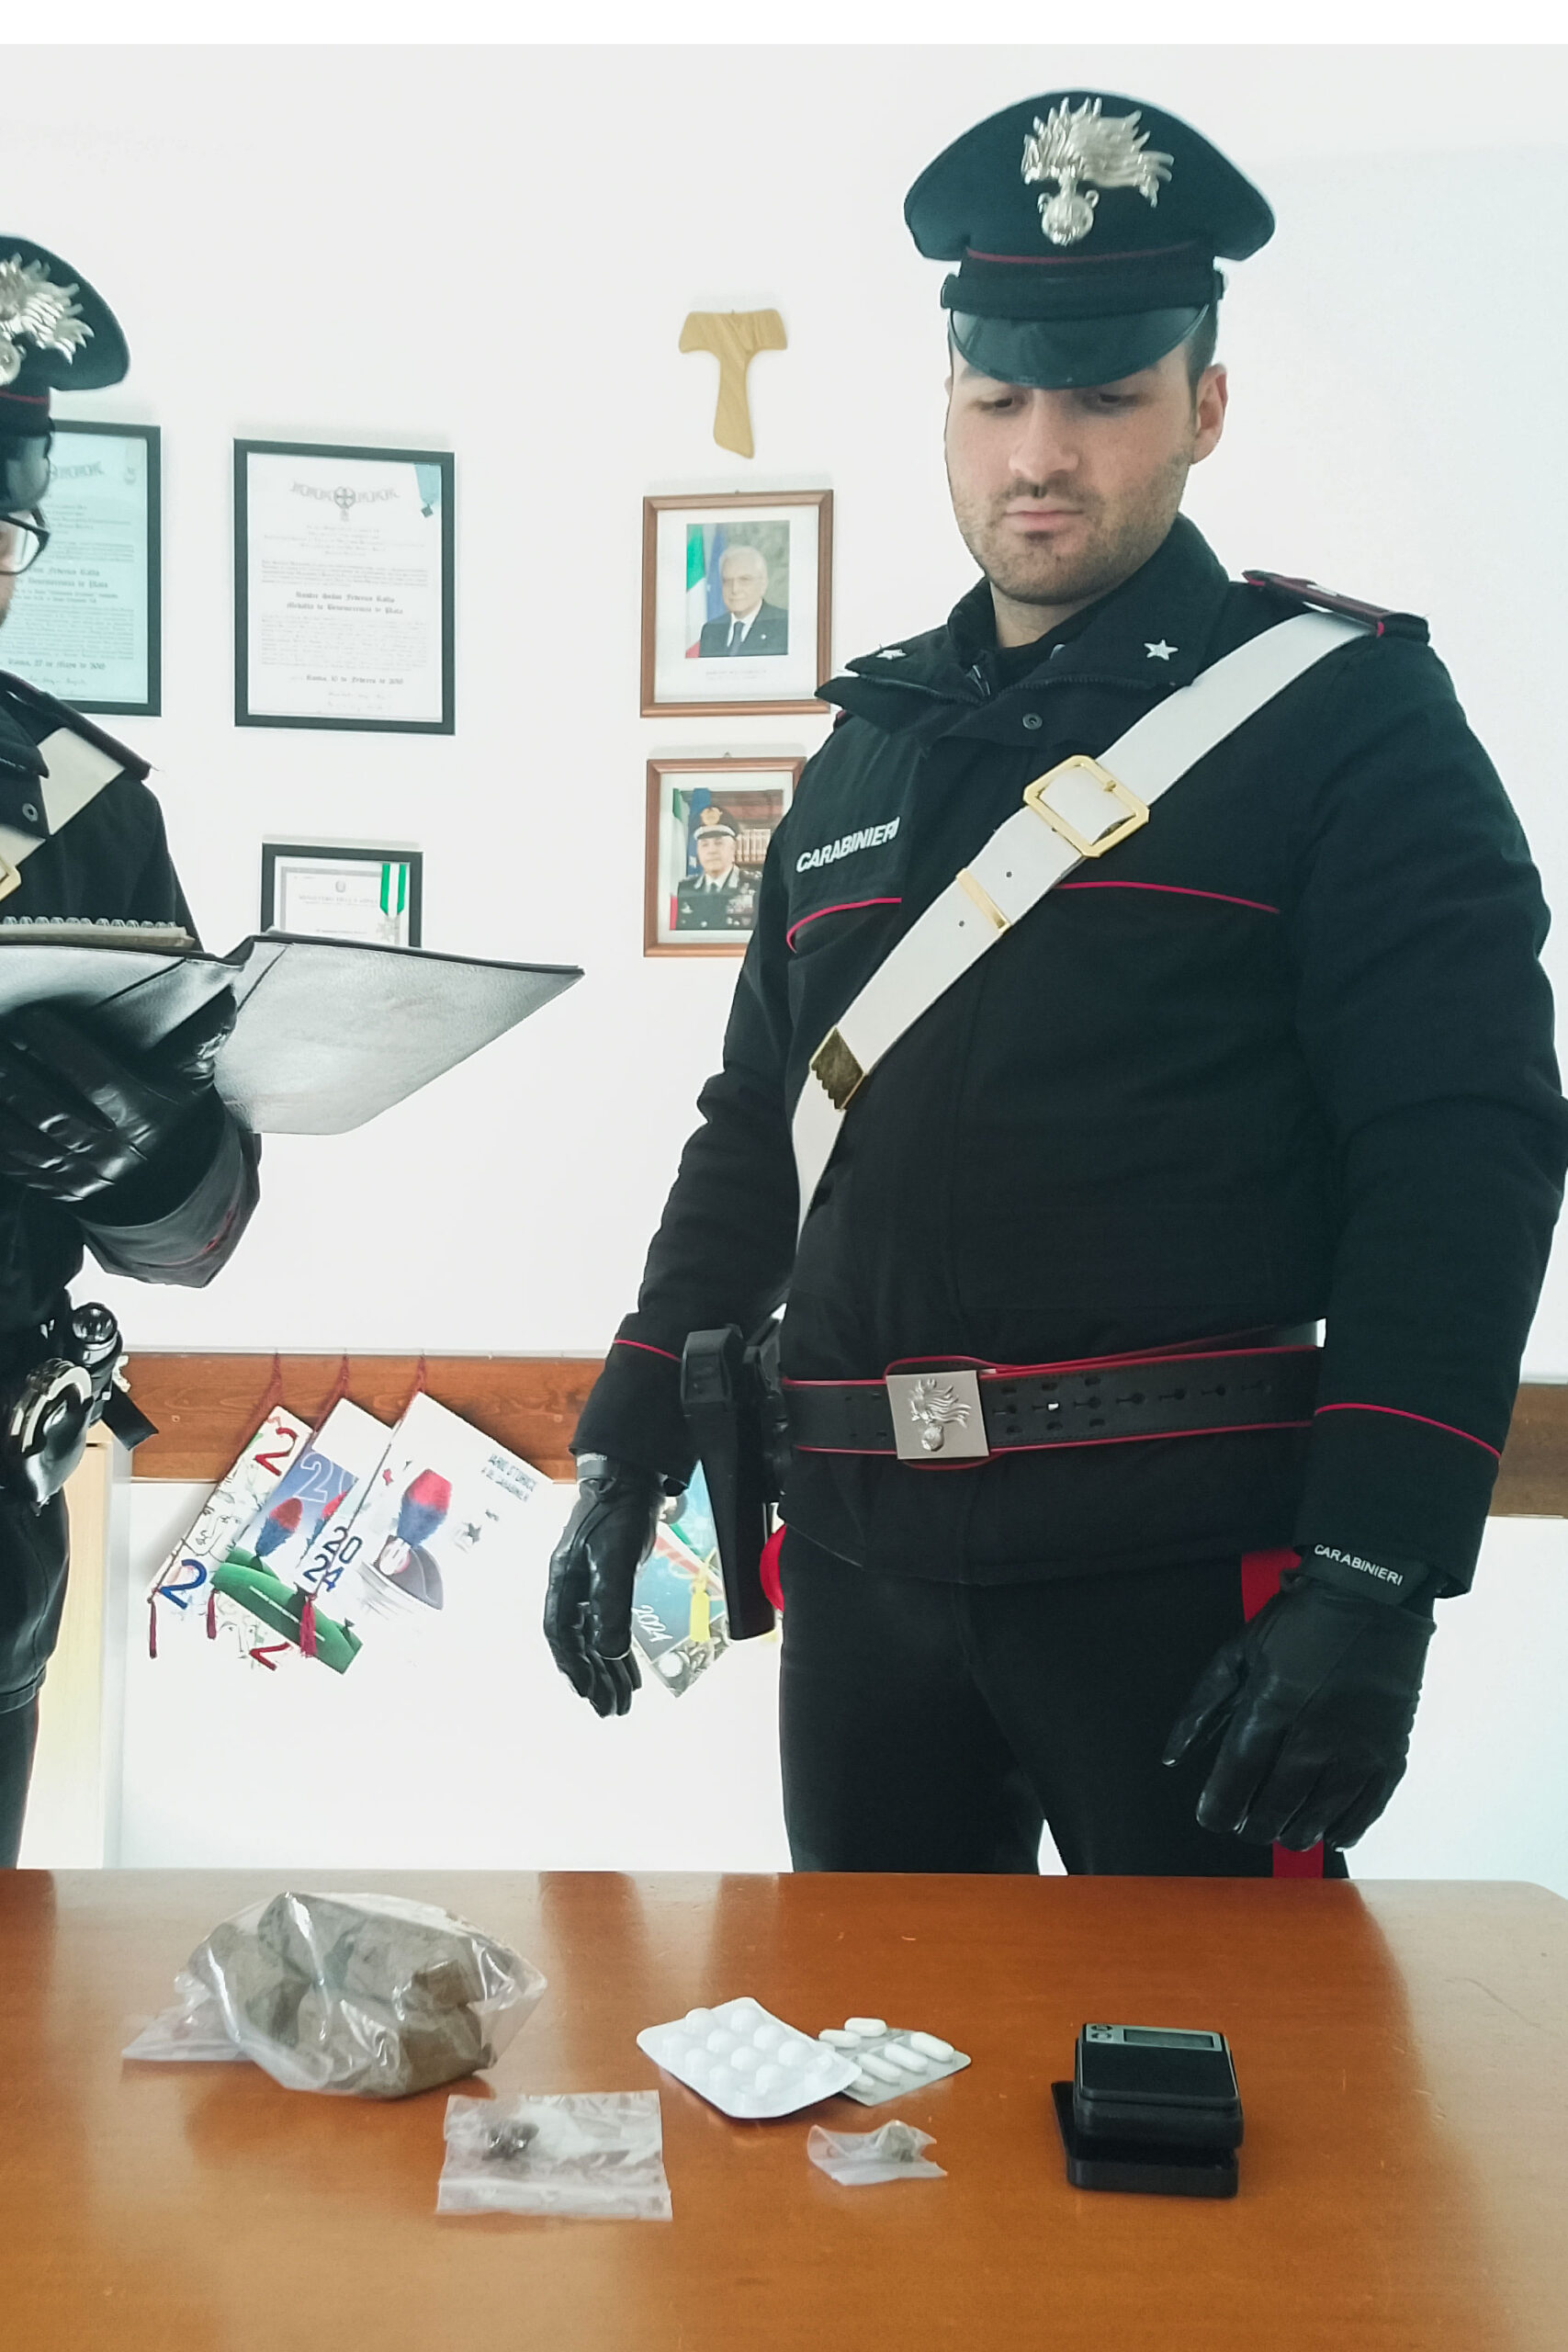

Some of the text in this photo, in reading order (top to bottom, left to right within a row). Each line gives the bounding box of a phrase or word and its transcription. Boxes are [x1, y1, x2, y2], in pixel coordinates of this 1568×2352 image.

[795, 816, 900, 873] CARABINIERI
[321, 1525, 364, 1565] 20
[1314, 1544, 1404, 1586] CARABINIERI
[302, 1553, 344, 1593] 24
